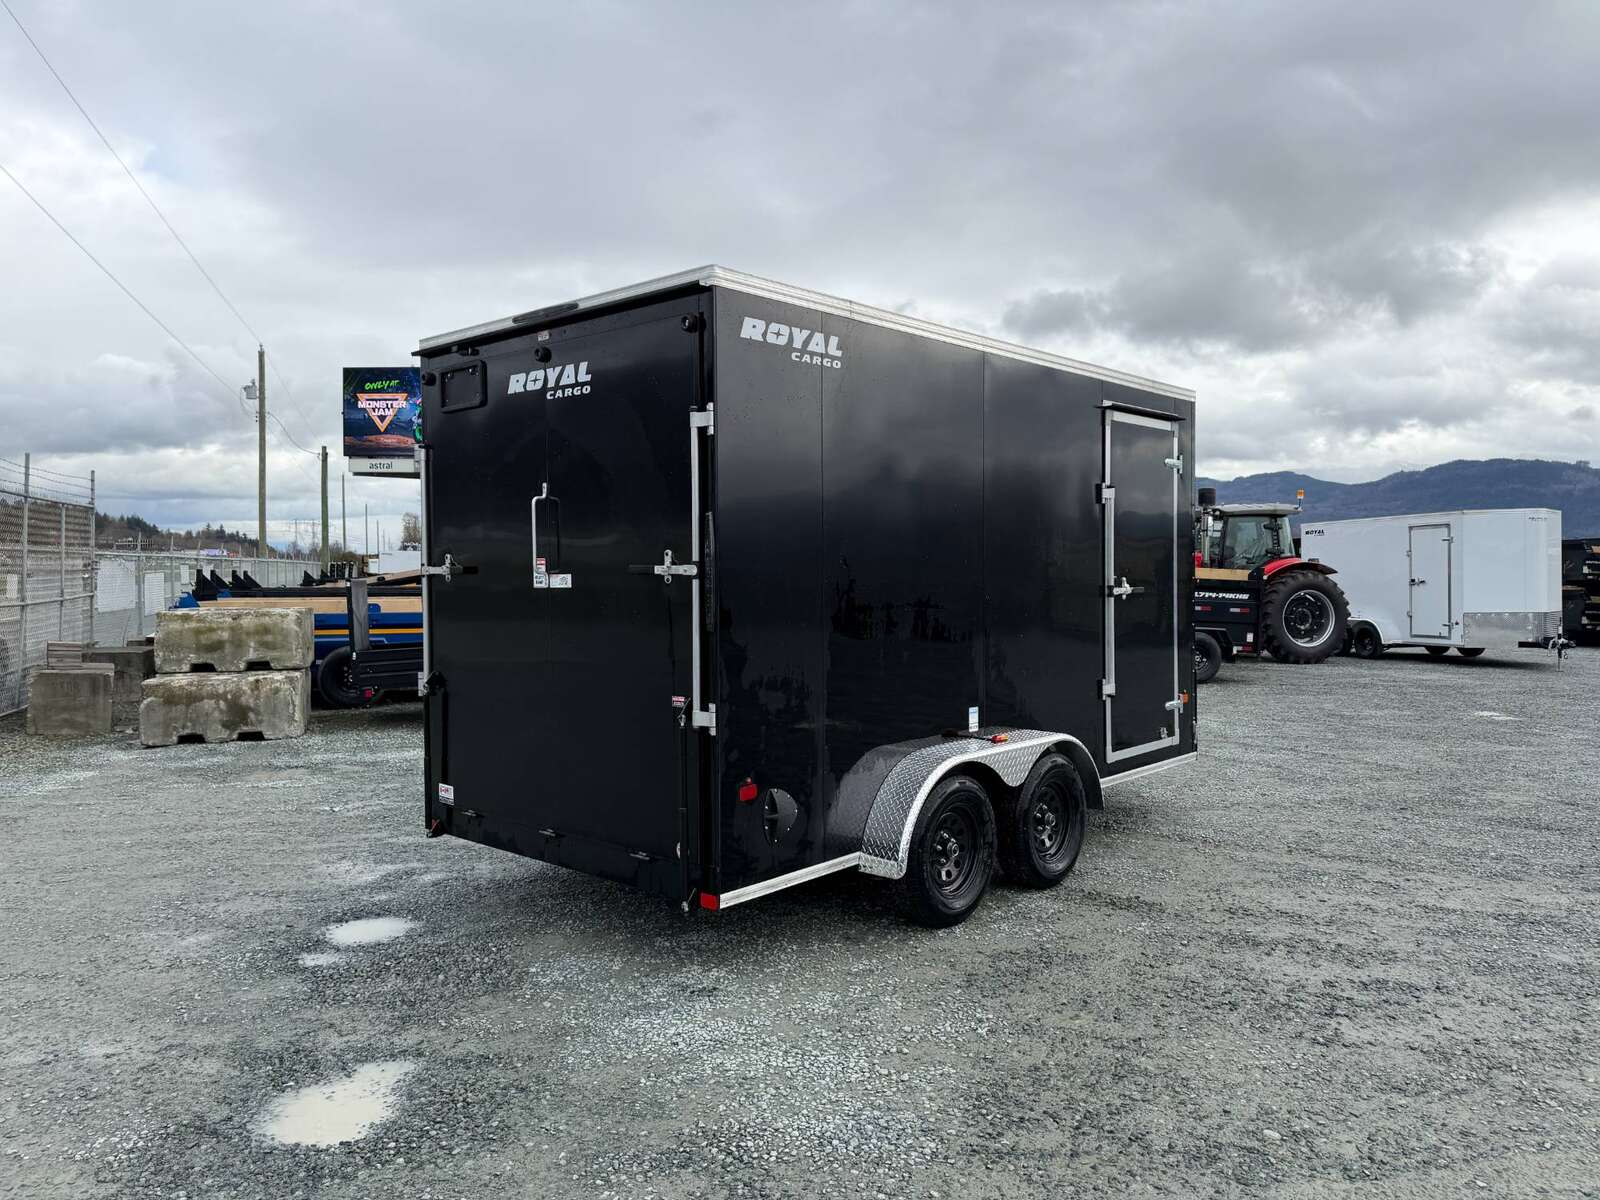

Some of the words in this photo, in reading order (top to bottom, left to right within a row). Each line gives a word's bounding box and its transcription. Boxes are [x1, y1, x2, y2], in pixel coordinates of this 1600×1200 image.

[740, 316, 843, 357] ROYAL
[791, 352, 842, 369] CARGO
[507, 361, 592, 395] ROYAL
[365, 381, 389, 390] ONLY
[546, 385, 591, 400] CARGO
[357, 400, 407, 409] MONSTER
[371, 408, 393, 416] JAM
[369, 462, 393, 470] astral
